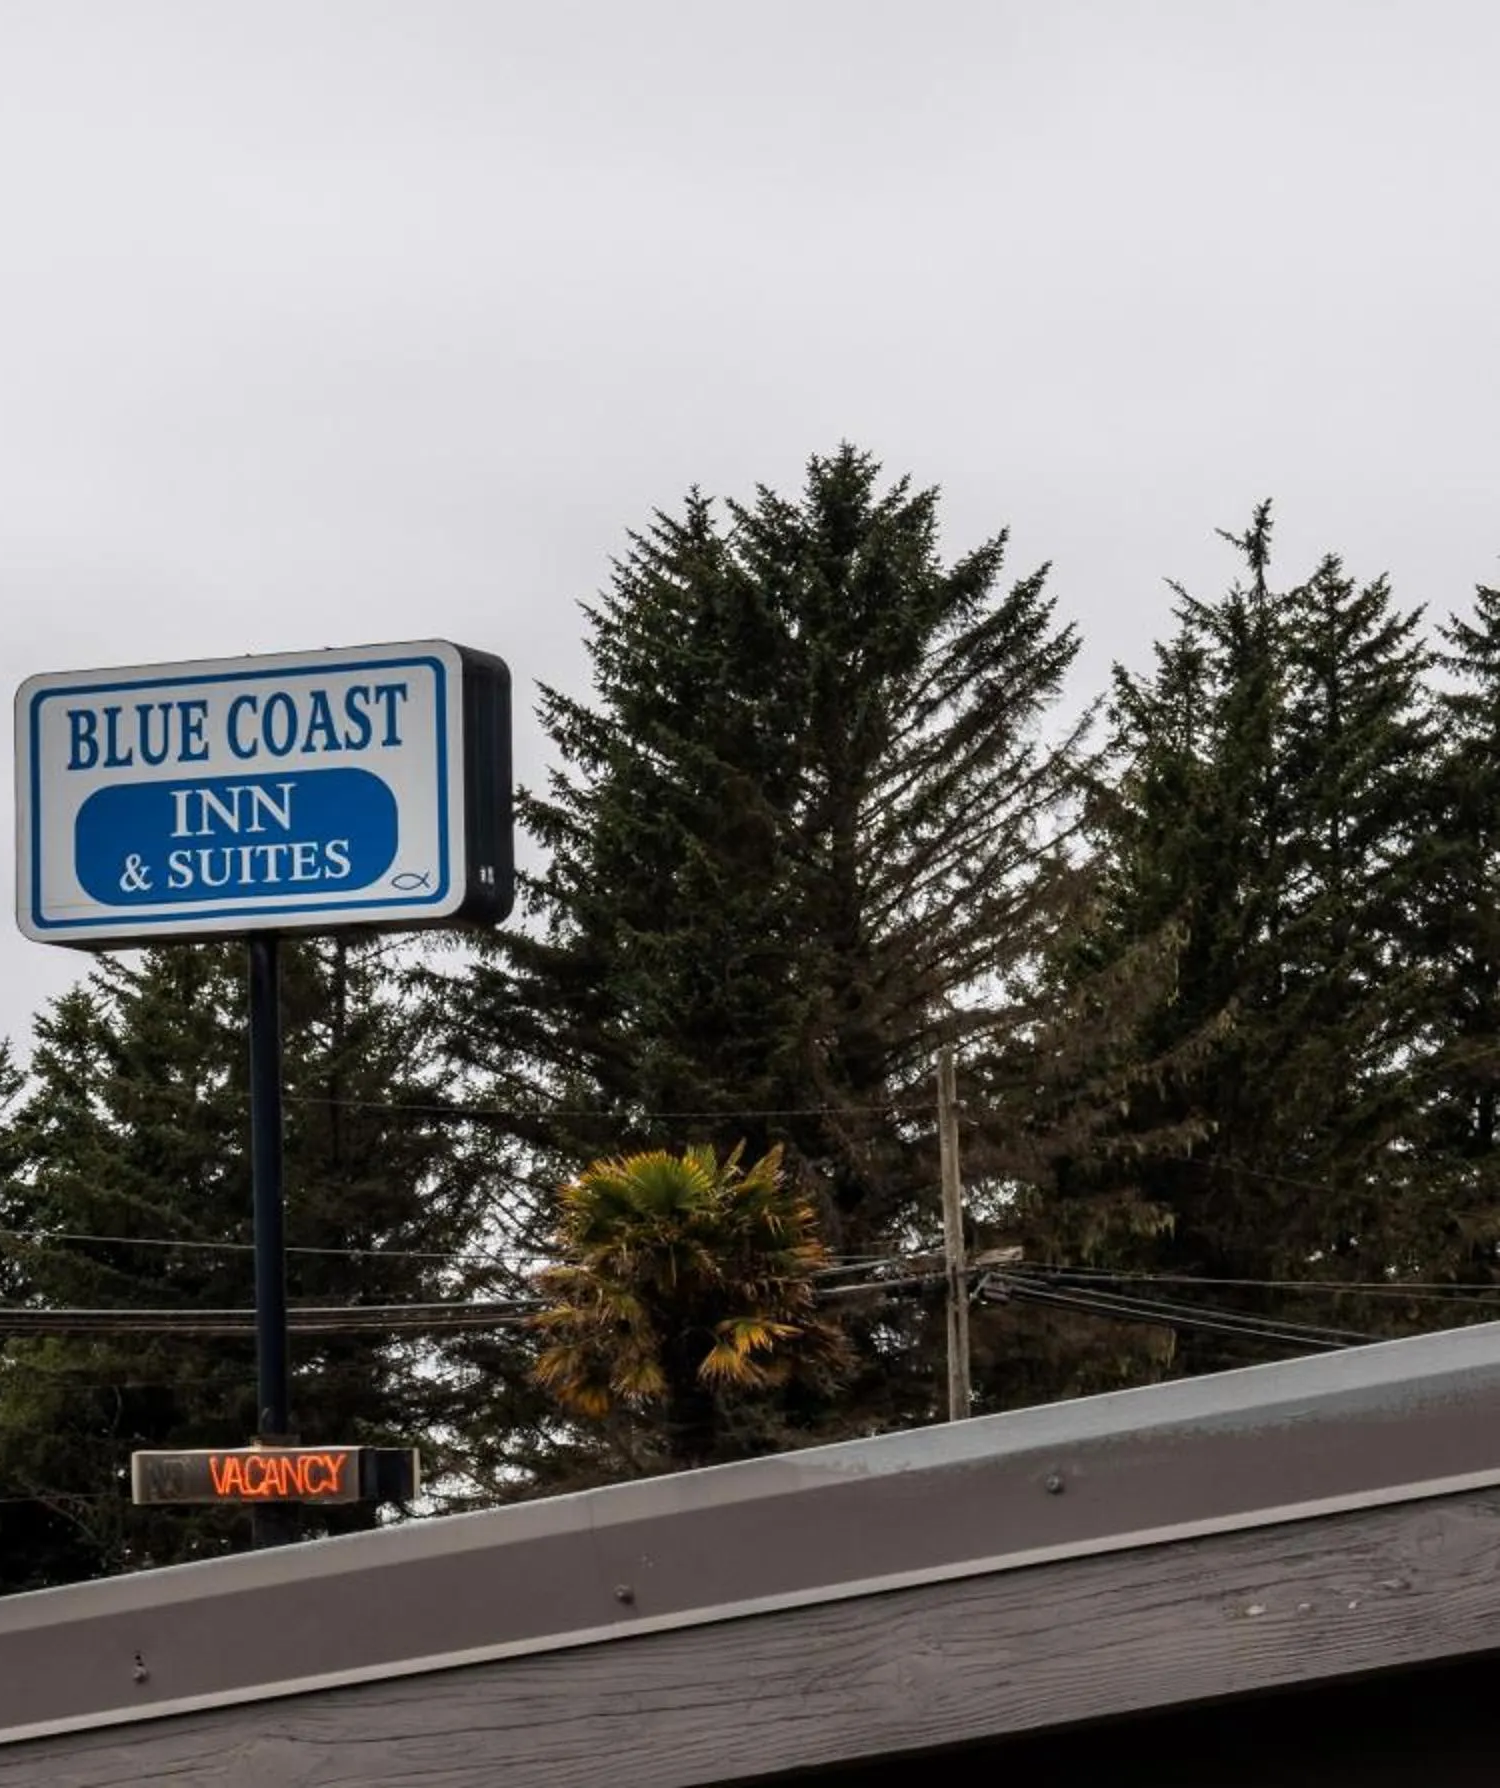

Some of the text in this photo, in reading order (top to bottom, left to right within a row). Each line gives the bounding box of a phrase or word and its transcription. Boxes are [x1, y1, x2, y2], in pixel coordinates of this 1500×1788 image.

[66, 683, 408, 771] BLUE COAST
[170, 783, 297, 838] INN
[119, 839, 352, 893] & SUITES
[209, 1454, 347, 1496] VACANCY
